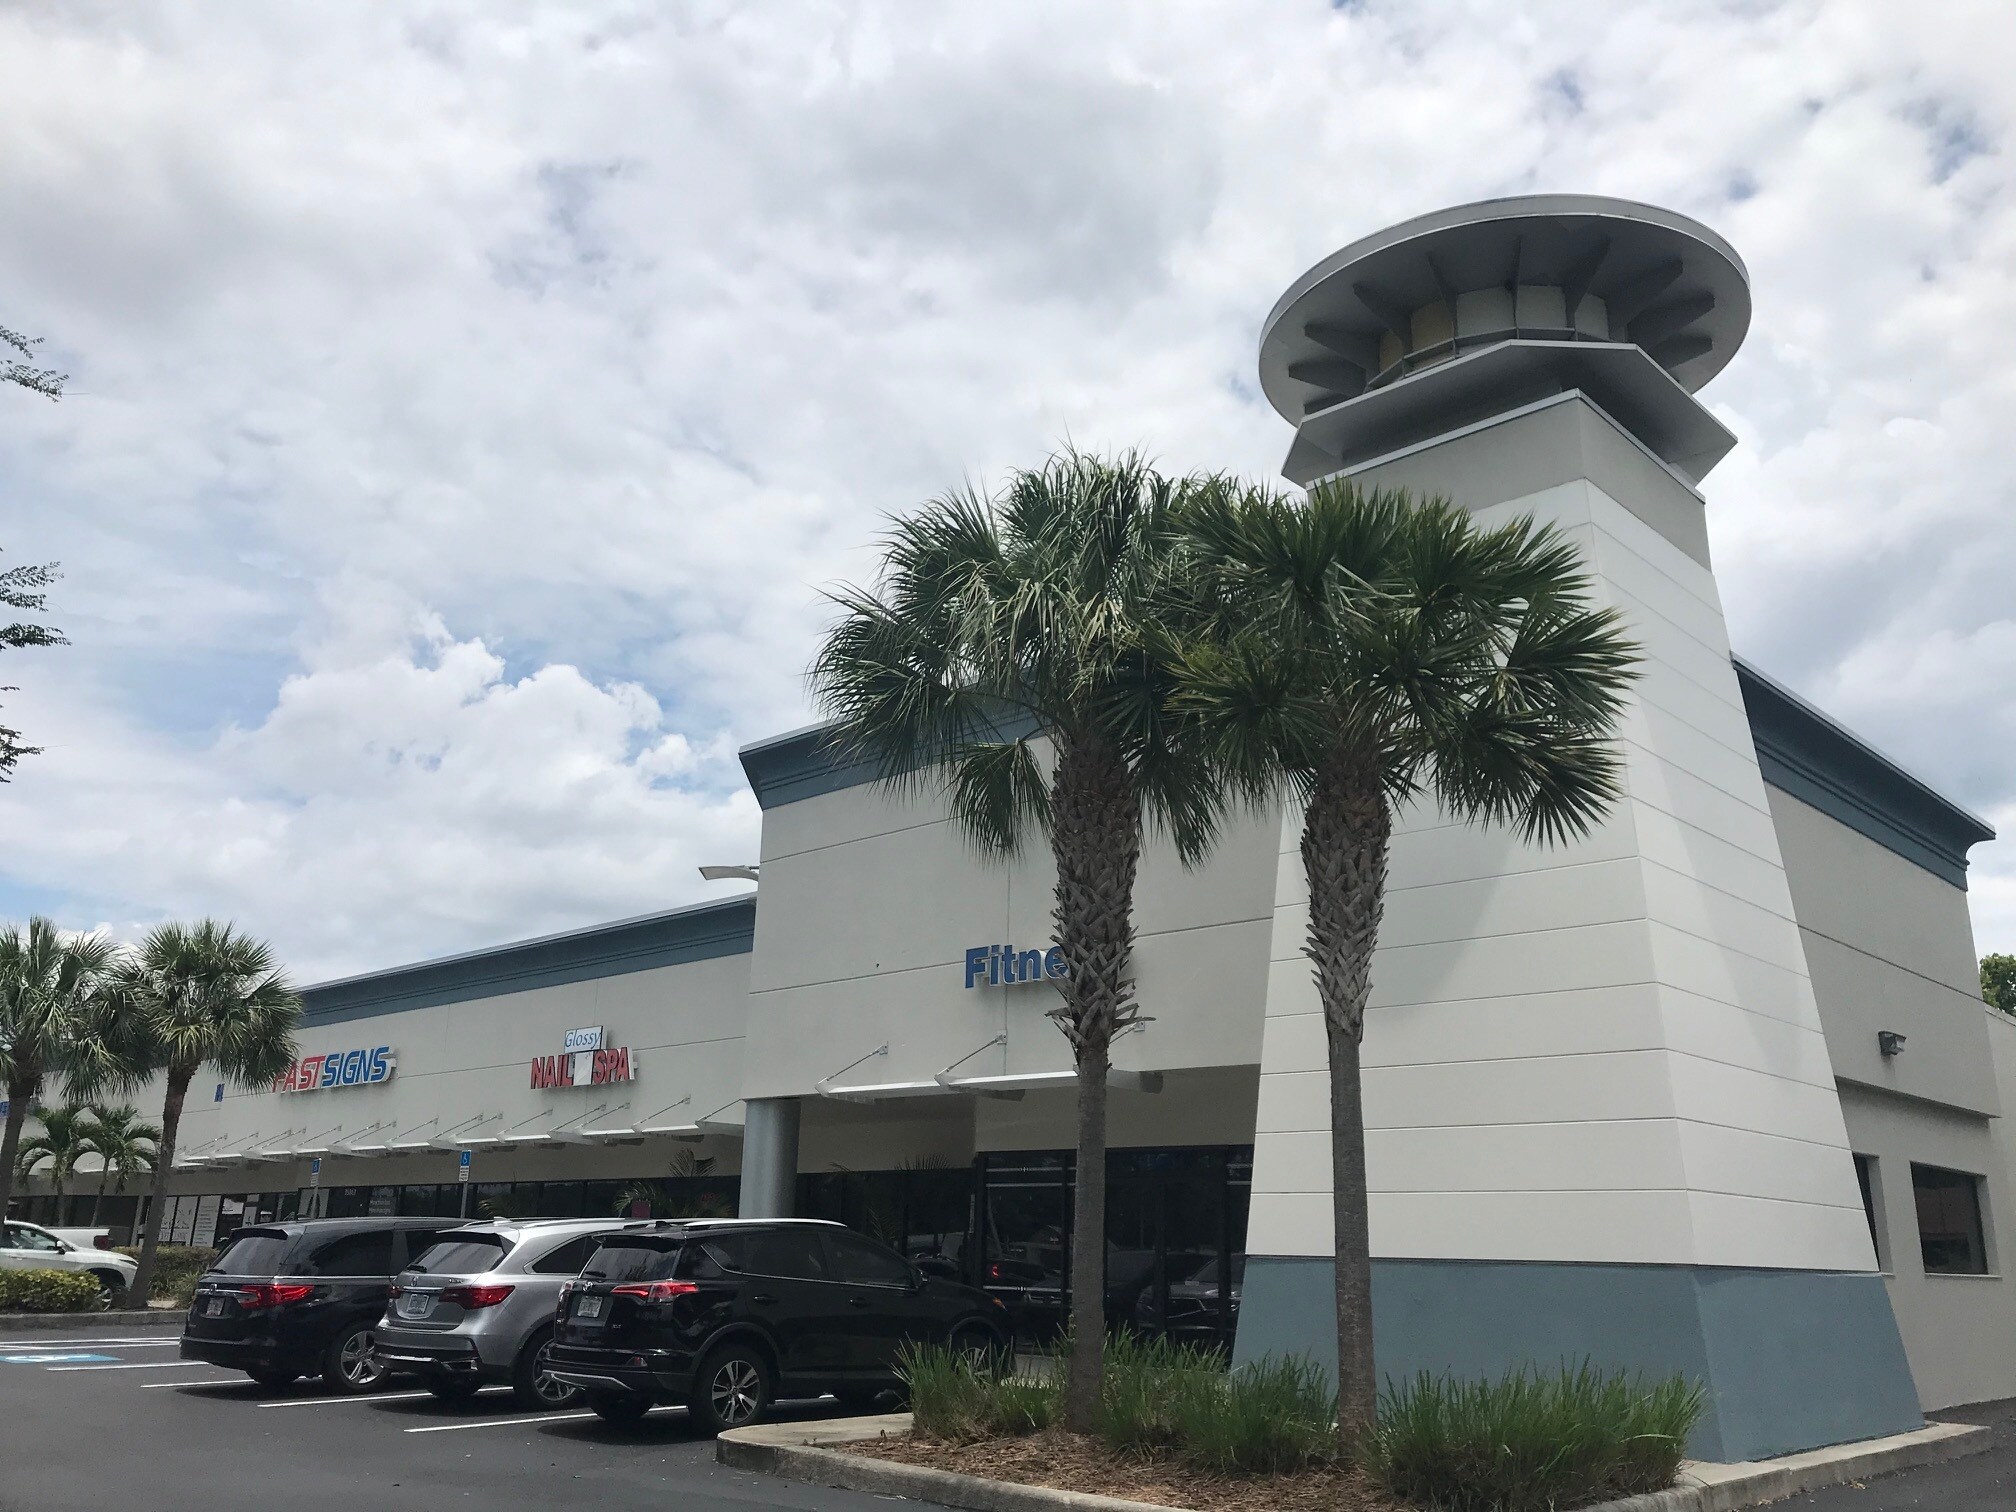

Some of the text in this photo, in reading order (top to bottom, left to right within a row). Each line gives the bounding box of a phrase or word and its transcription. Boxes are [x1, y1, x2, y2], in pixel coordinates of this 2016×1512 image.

[565, 1032, 601, 1050] Glossy
[531, 1047, 630, 1090] NAIL SPA
